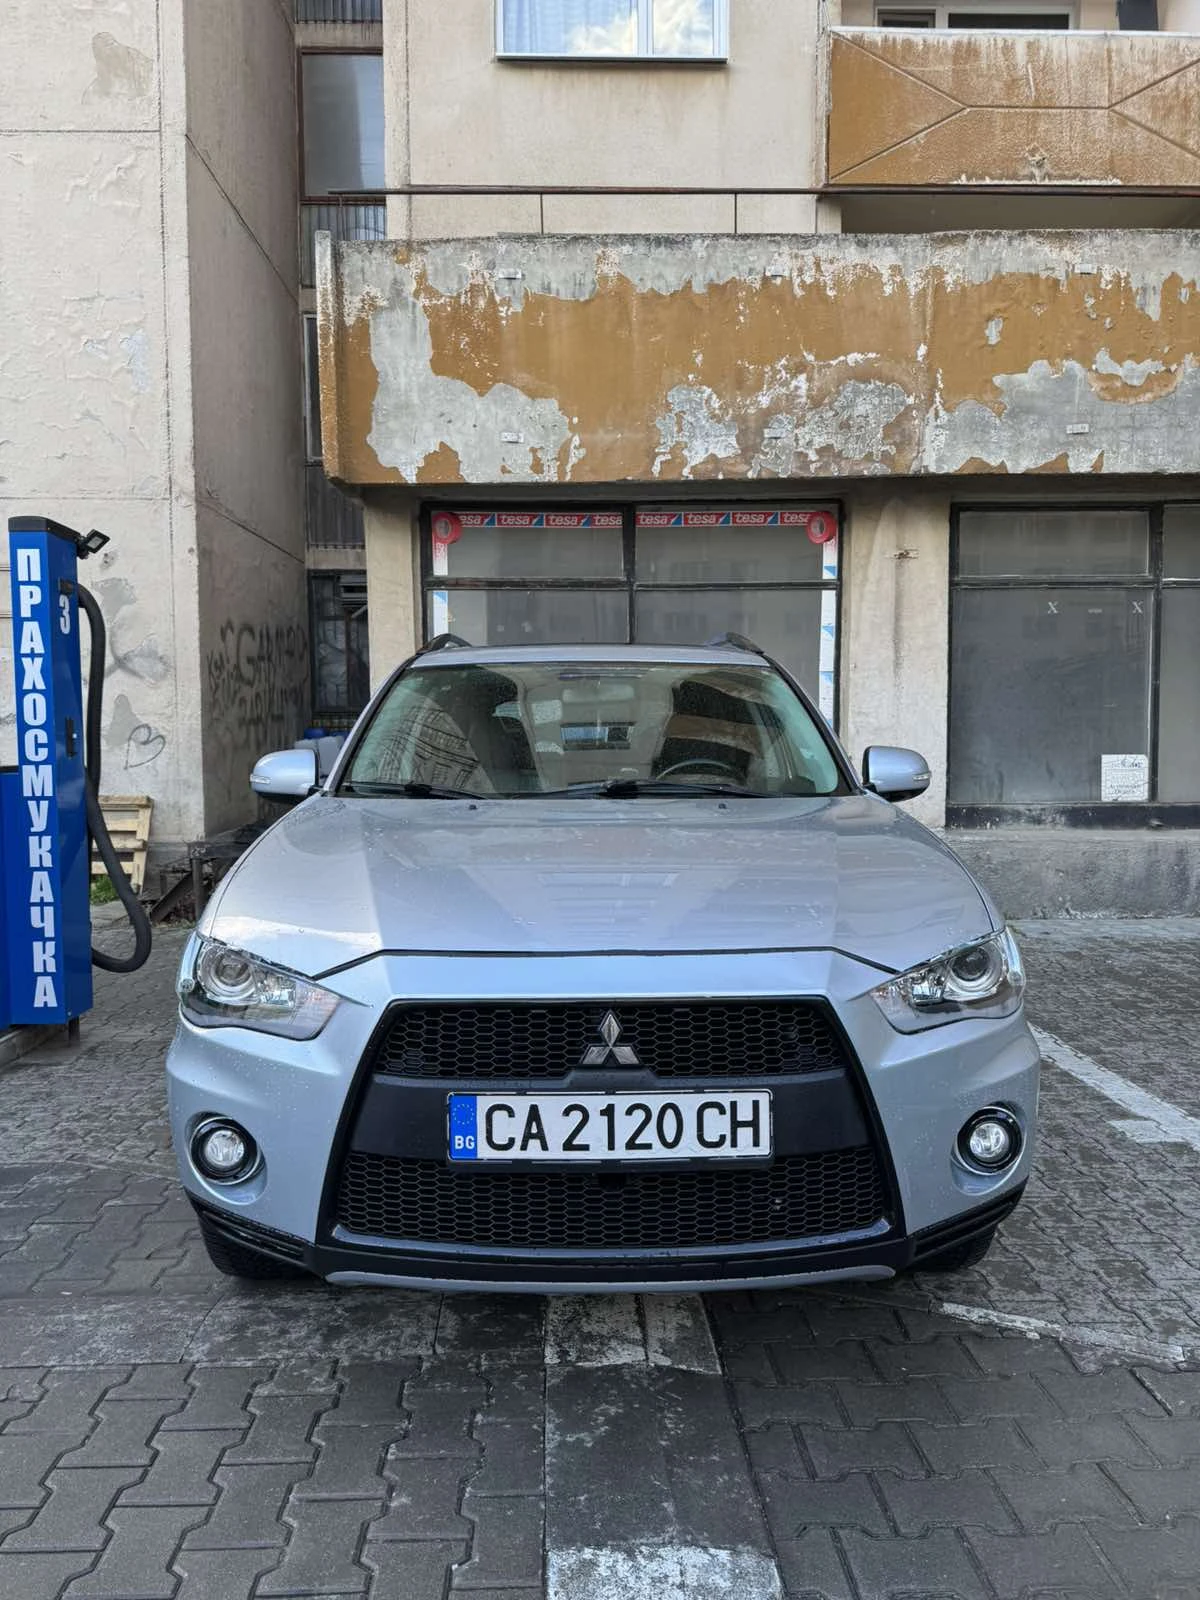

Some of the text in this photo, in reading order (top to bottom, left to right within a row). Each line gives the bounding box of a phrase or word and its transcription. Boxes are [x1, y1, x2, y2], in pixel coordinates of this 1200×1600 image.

[460, 514, 623, 526] esa tesa tesa tesa
[638, 512, 669, 525] tesa
[687, 512, 717, 525] tesa
[735, 512, 766, 524] tesa
[59, 594, 71, 635] 3
[17, 548, 58, 1008] ПРАХОСМУКАЧКА
[562, 1102, 684, 1151] 2120
[454, 1136, 475, 1149] BG
